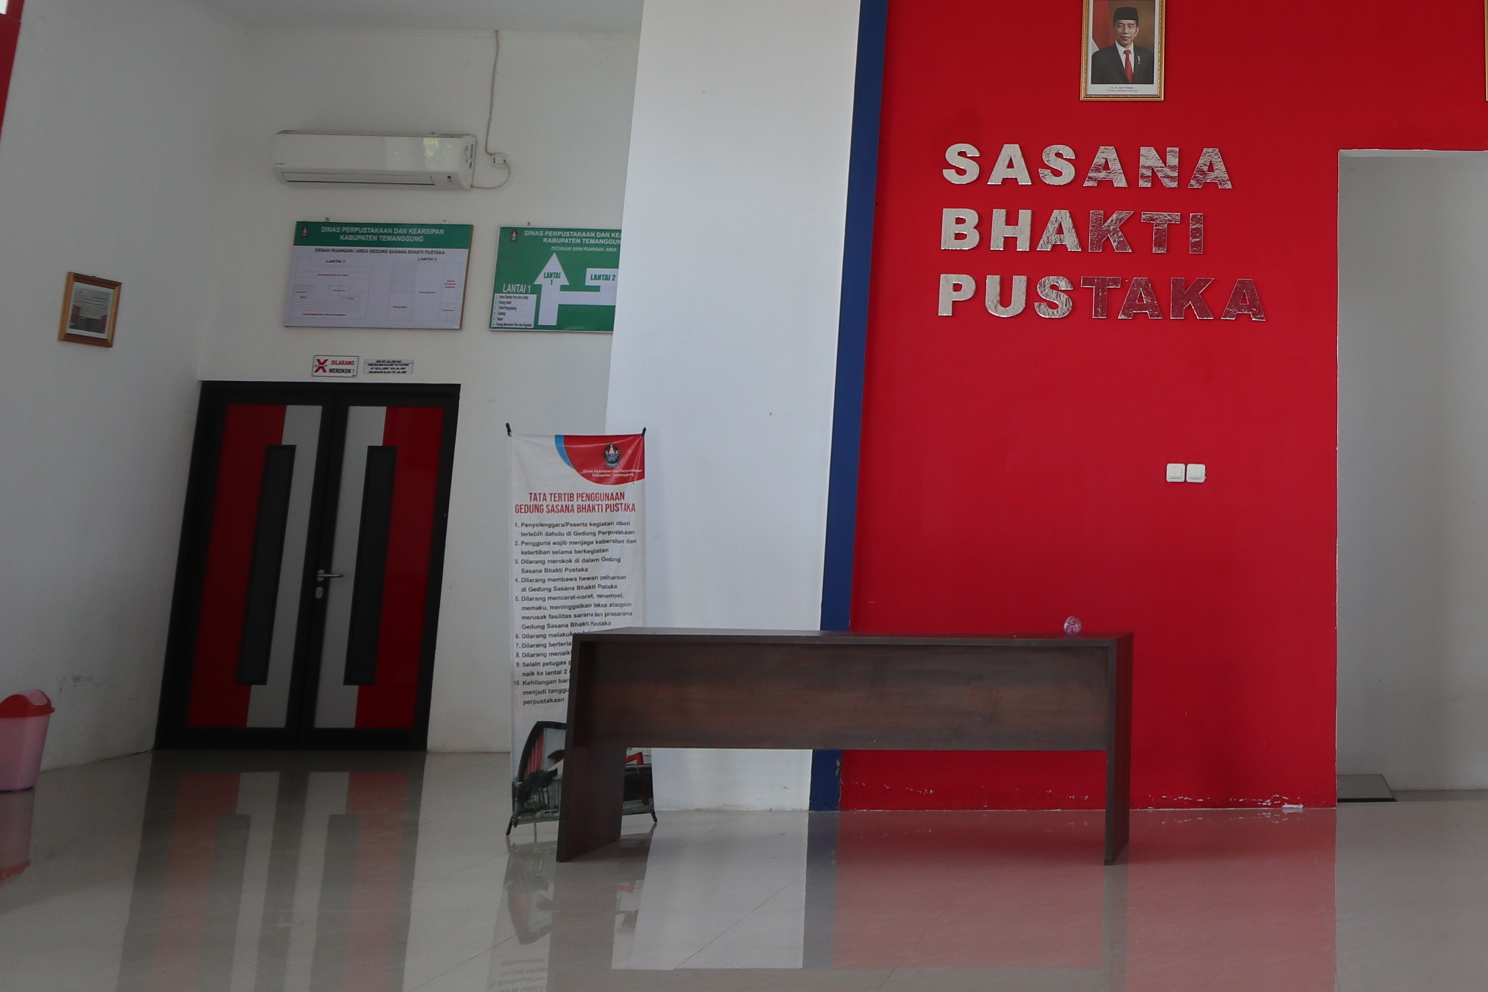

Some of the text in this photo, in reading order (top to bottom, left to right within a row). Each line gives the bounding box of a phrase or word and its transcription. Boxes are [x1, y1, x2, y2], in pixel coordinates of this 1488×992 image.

[942, 143, 1233, 190] SASANA
[940, 208, 1204, 255] BHAKTI
[503, 284, 531, 293] LANTAI 1
[938, 274, 1266, 321] PUSTAKA
[515, 503, 636, 514] GEDUNG SASANA BHAKTI PUSTAKA
[529, 492, 625, 502] TATA TERTIB PENGGUNAAN
